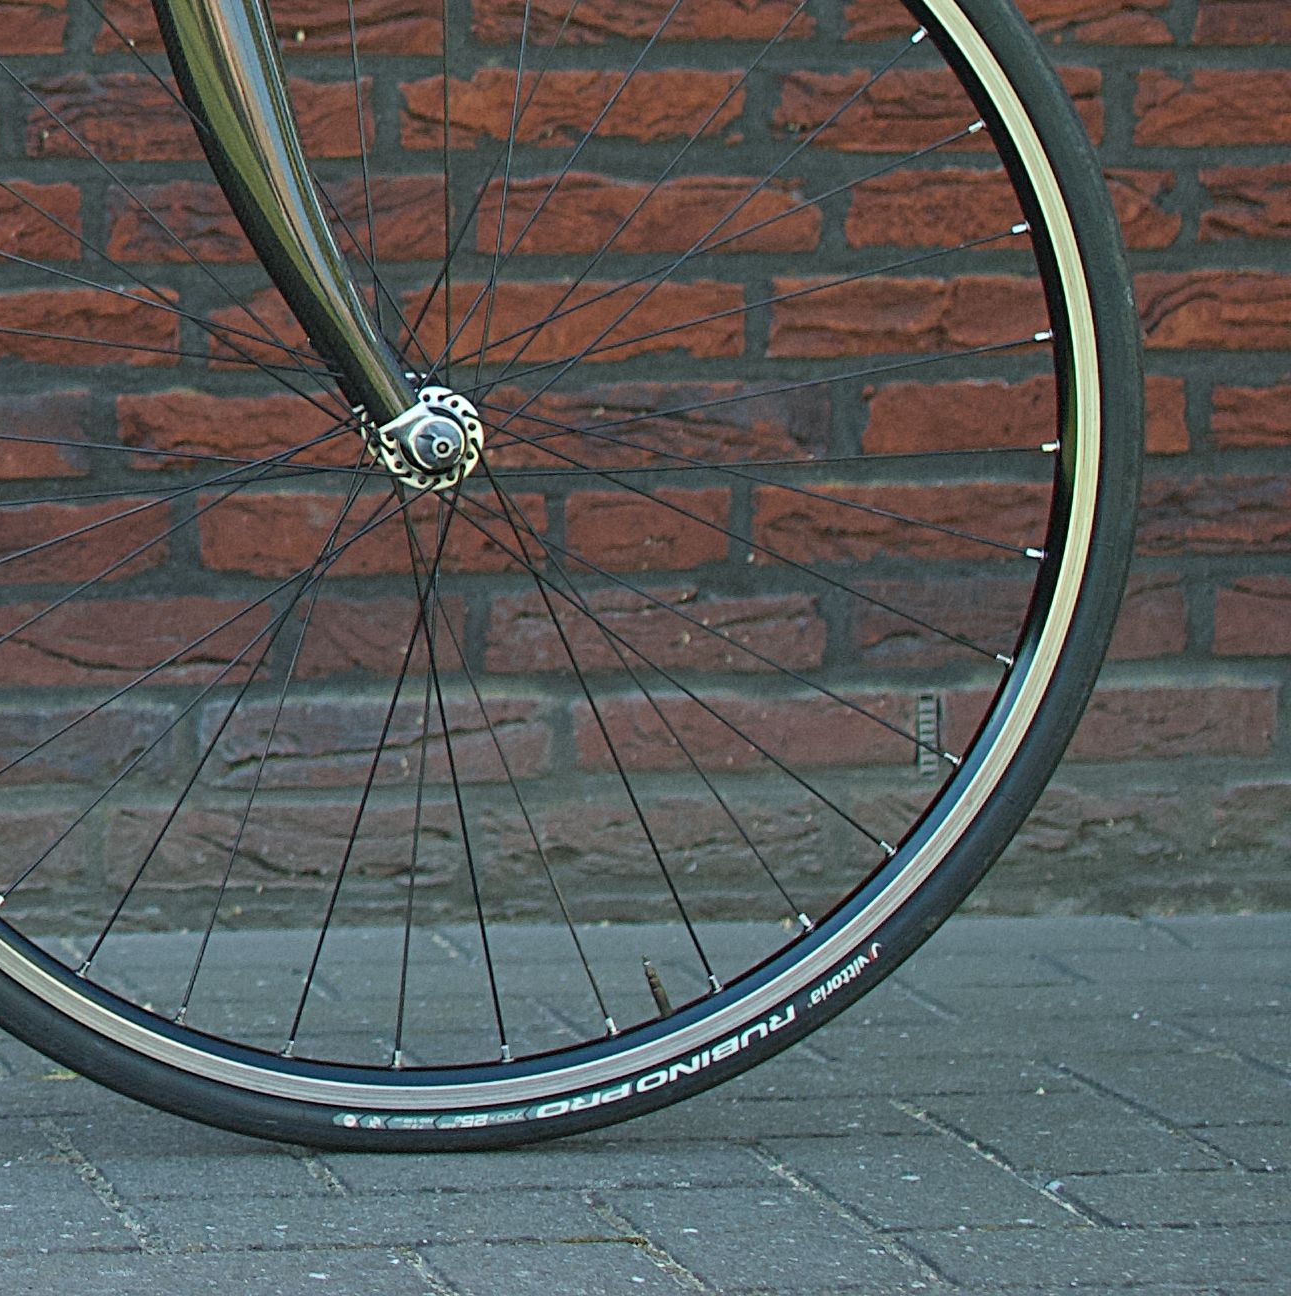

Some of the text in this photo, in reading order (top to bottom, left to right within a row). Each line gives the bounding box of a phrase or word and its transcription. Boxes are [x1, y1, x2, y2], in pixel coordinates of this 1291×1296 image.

[809, 953, 872, 1005] vittoria
[536, 1009, 796, 1119] RUBINO PRO
